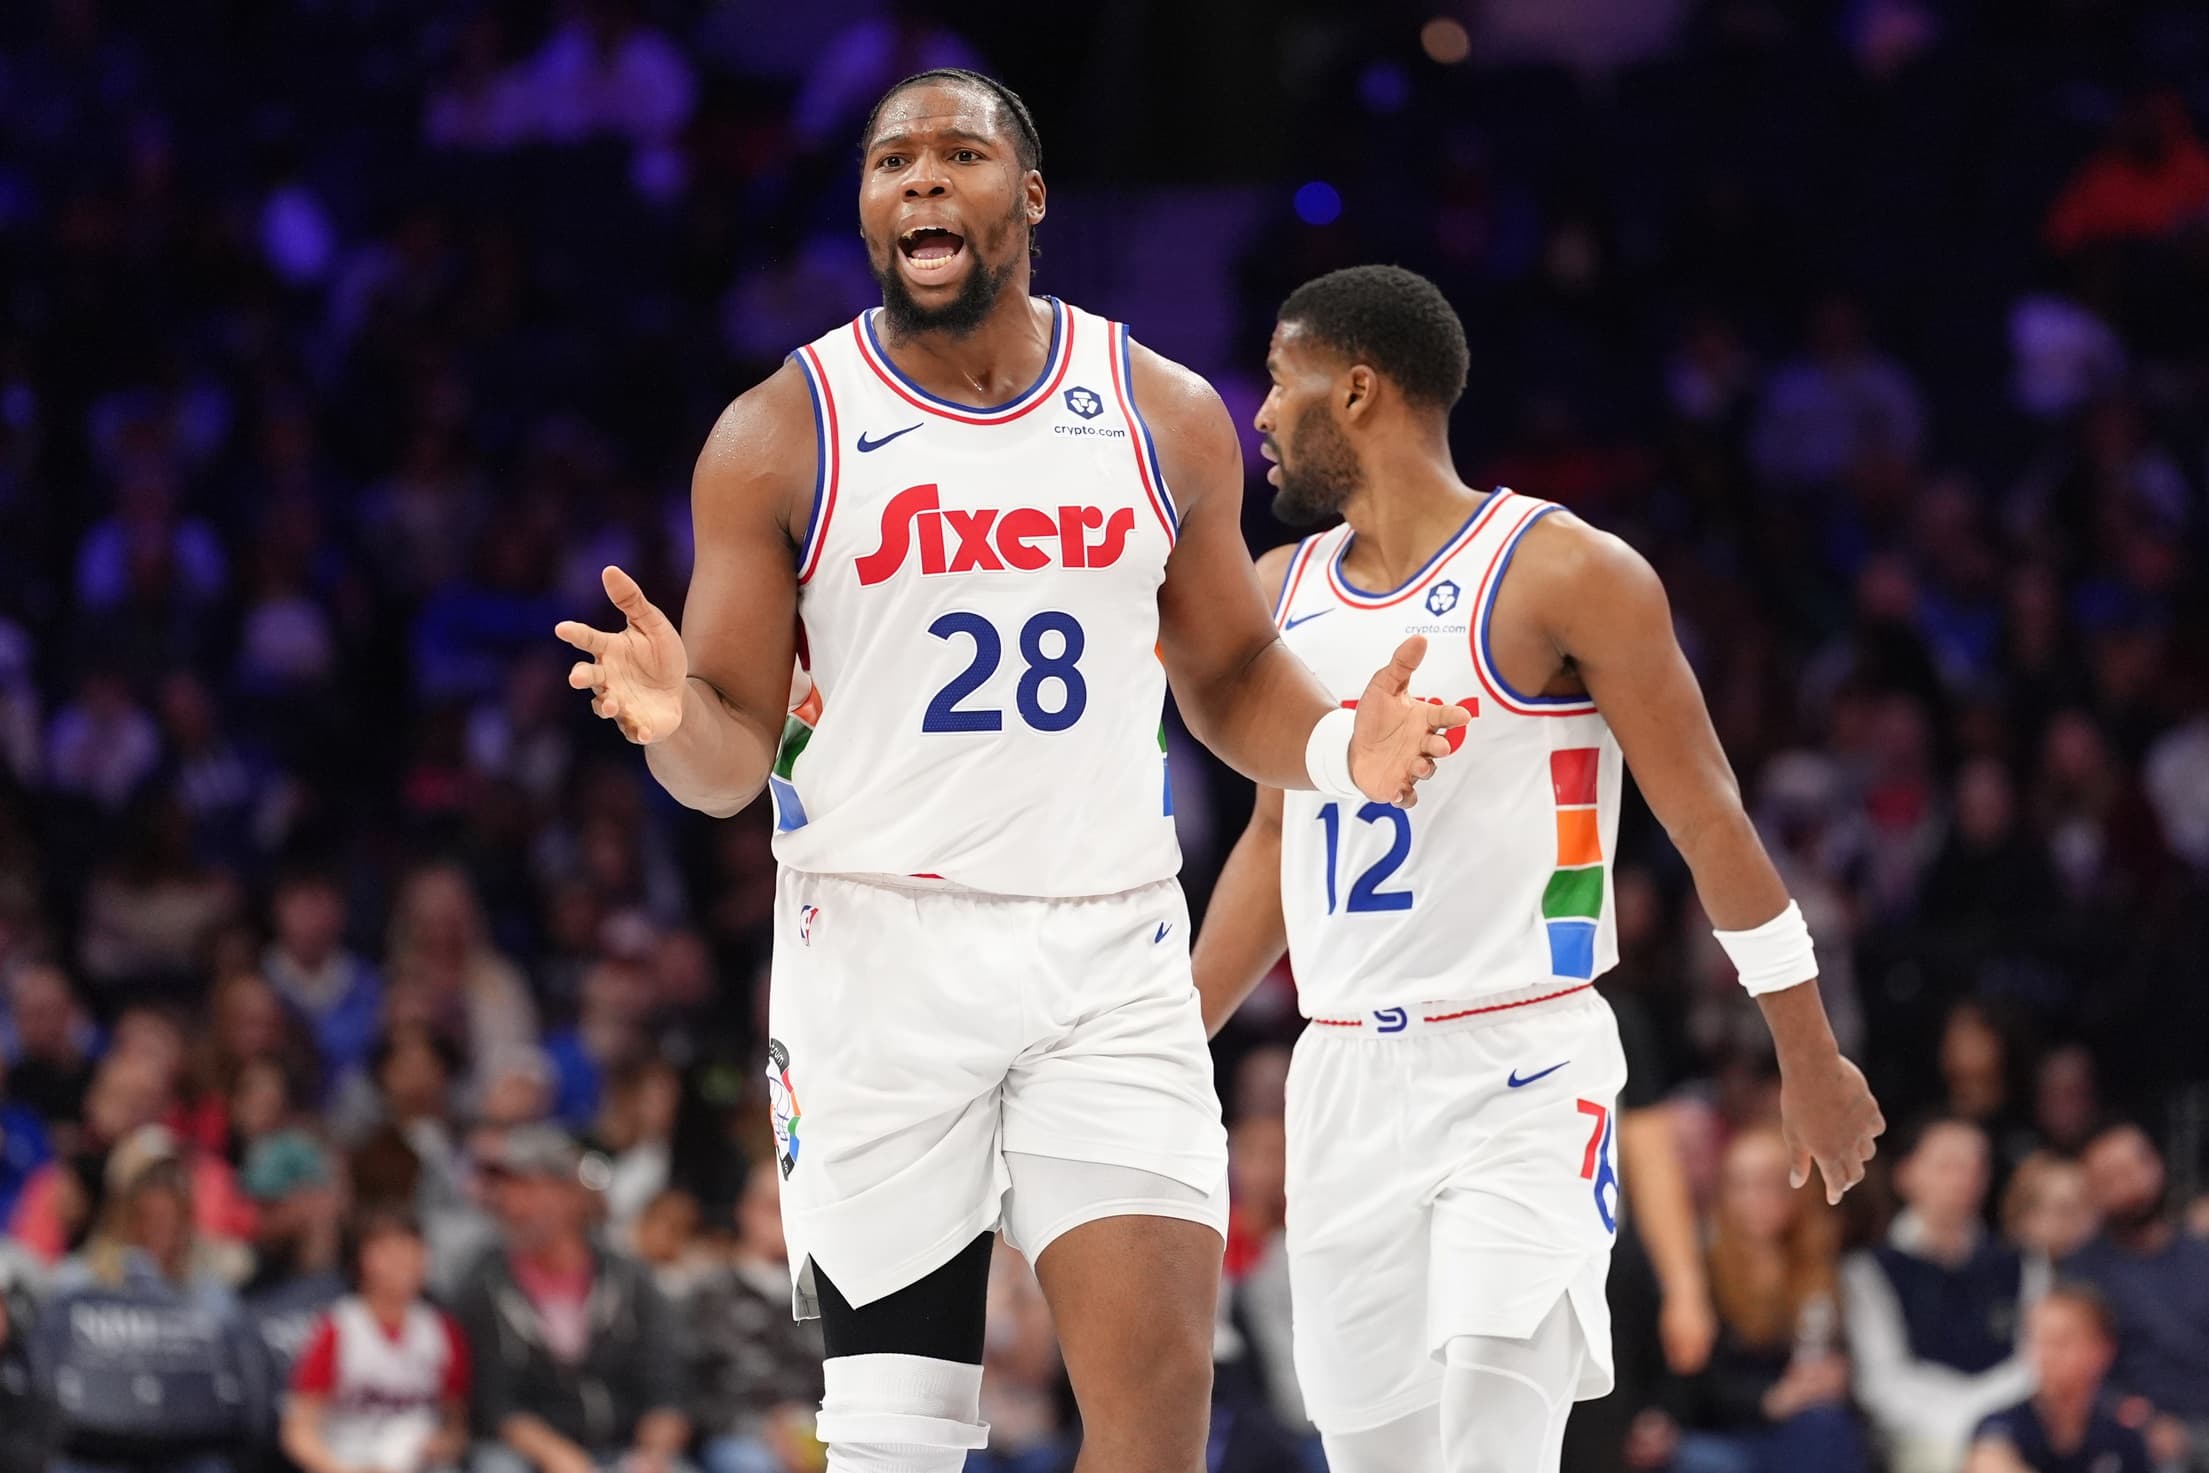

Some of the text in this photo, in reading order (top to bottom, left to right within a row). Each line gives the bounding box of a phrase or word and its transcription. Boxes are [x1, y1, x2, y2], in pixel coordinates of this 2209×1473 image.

[1054, 425, 1125, 438] crypto.com
[854, 483, 1135, 586] Sixers
[922, 611, 1087, 733] 28
[1405, 624, 1466, 635] crypto.com
[1316, 801, 1413, 915] 12
[1577, 1098, 1619, 1234] 76
